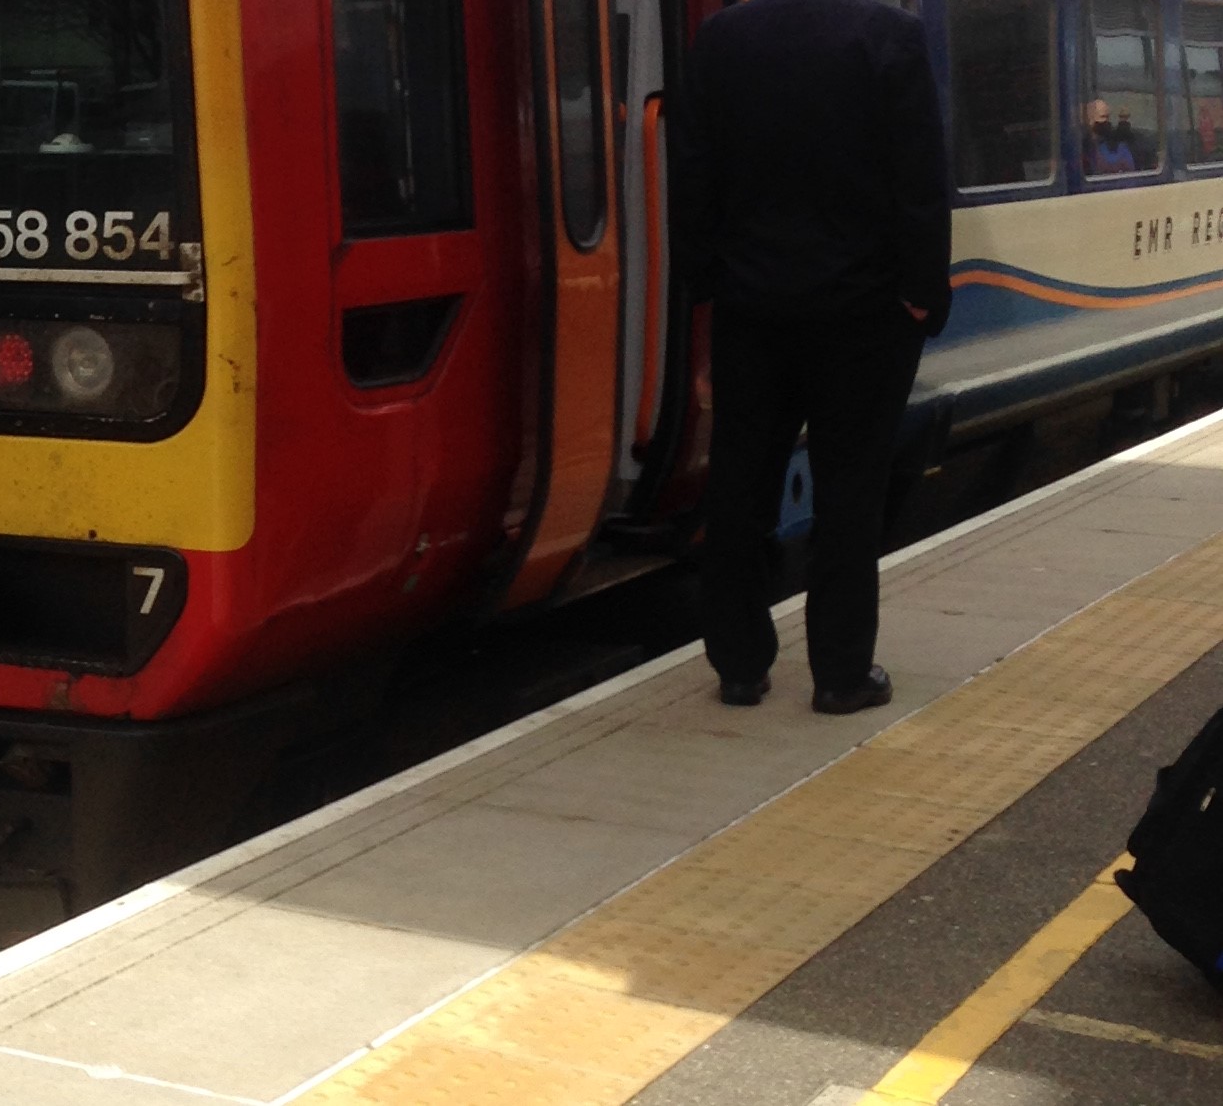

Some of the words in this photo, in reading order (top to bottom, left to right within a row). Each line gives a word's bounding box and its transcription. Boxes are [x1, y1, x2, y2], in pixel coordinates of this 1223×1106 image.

[64, 210, 175, 261] 854
[1134, 216, 1172, 257] EMR
[132, 566, 165, 614] 7
